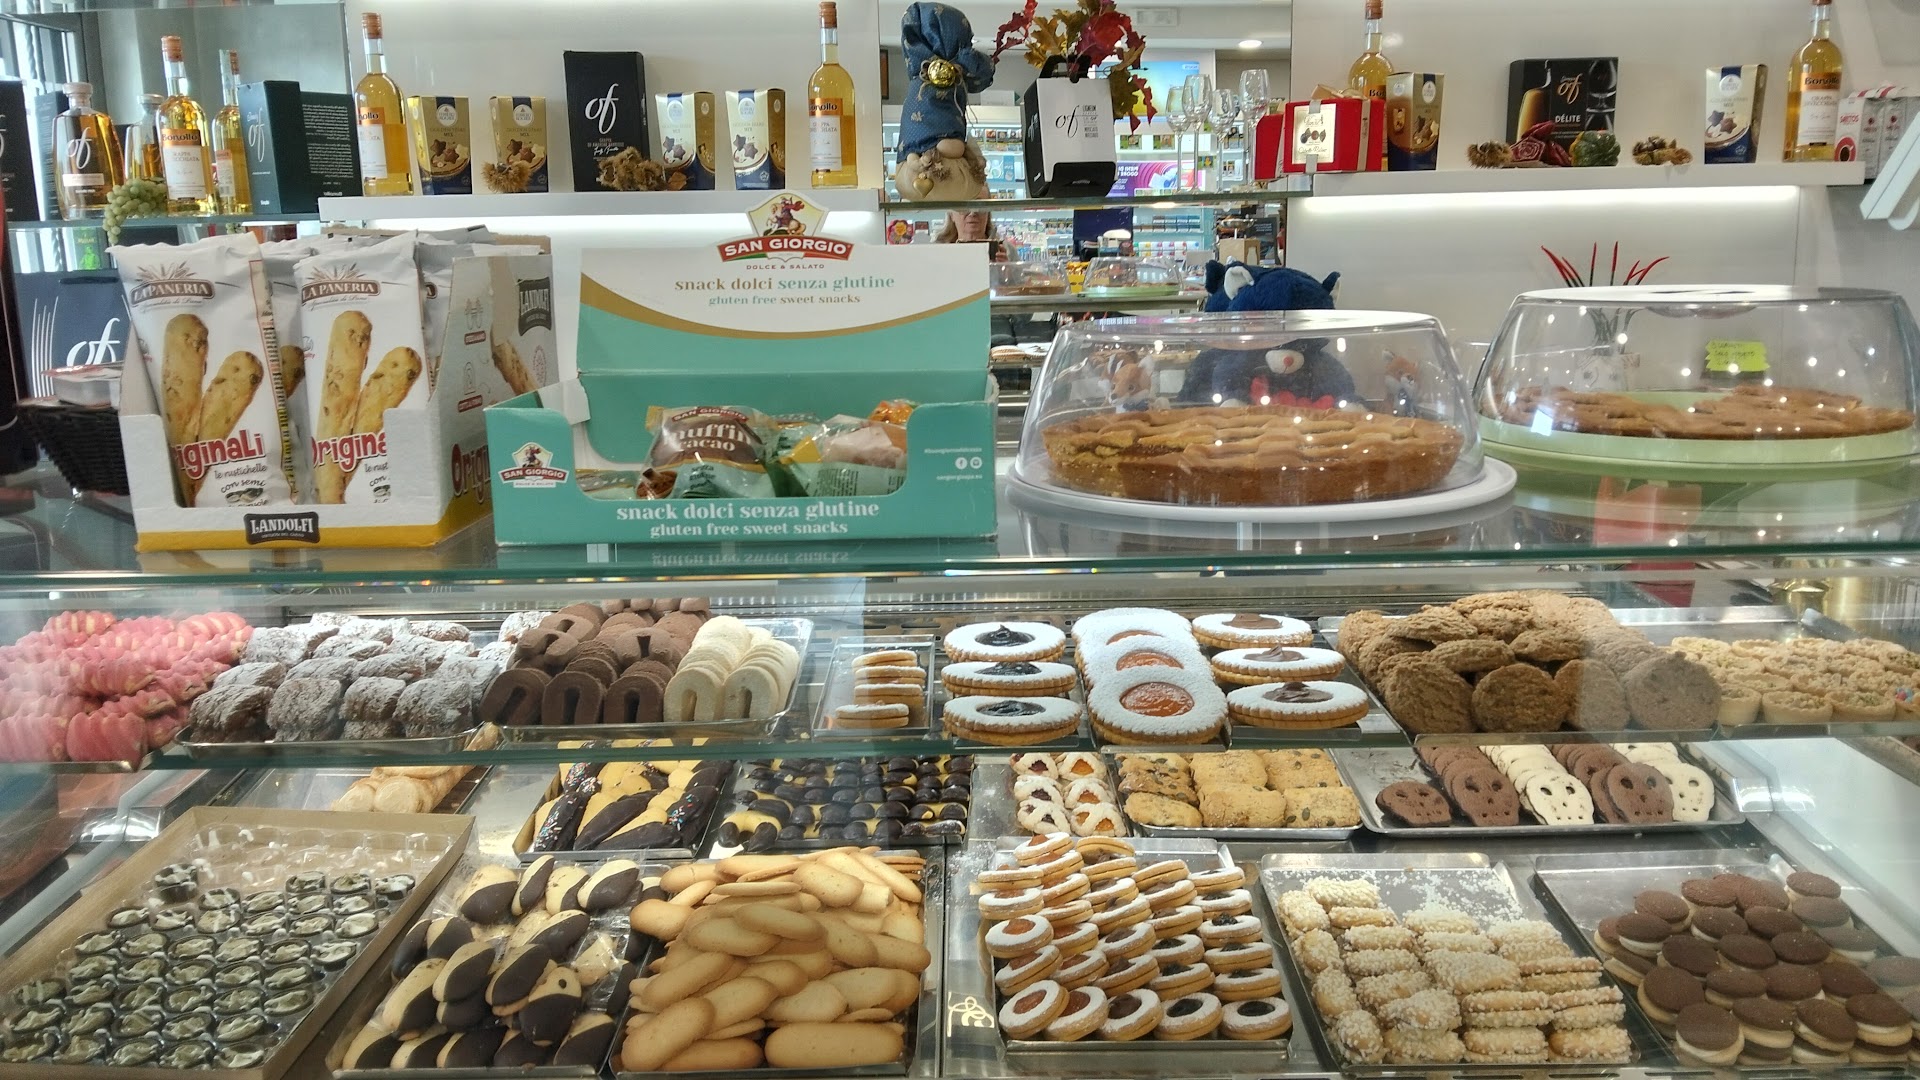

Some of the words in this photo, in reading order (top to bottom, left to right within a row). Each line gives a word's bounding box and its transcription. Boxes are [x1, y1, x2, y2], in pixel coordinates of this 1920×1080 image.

[1558, 73, 1583, 104] of
[585, 84, 619, 134] of
[1055, 105, 1080, 138] of
[1555, 114, 1581, 123] DÉLITE
[724, 240, 763, 257] SAN
[769, 238, 847, 255] GIORGIO
[303, 287, 317, 300] LA
[319, 283, 375, 295] PANERIA
[674, 278, 726, 291] snack
[731, 277, 773, 290] dolci
[777, 279, 827, 290] senza
[832, 276, 895, 292] glutine
[709, 296, 751, 306] gluten
[752, 295, 777, 305] free
[780, 295, 815, 304] sweet
[819, 294, 861, 304] snacks
[503, 470, 523, 479] SAN
[525, 469, 564, 479] GIORGIO
[221, 482, 239, 493] con
[616, 503, 678, 520] snack
[683, 503, 733, 519] dolci
[739, 504, 799, 519] senza
[805, 501, 879, 521] glutine
[250, 517, 314, 535] LANDOLFI
[650, 524, 701, 539] gluten
[706, 523, 739, 535] free
[743, 523, 787, 535] sweet
[793, 521, 848, 534] snacks
